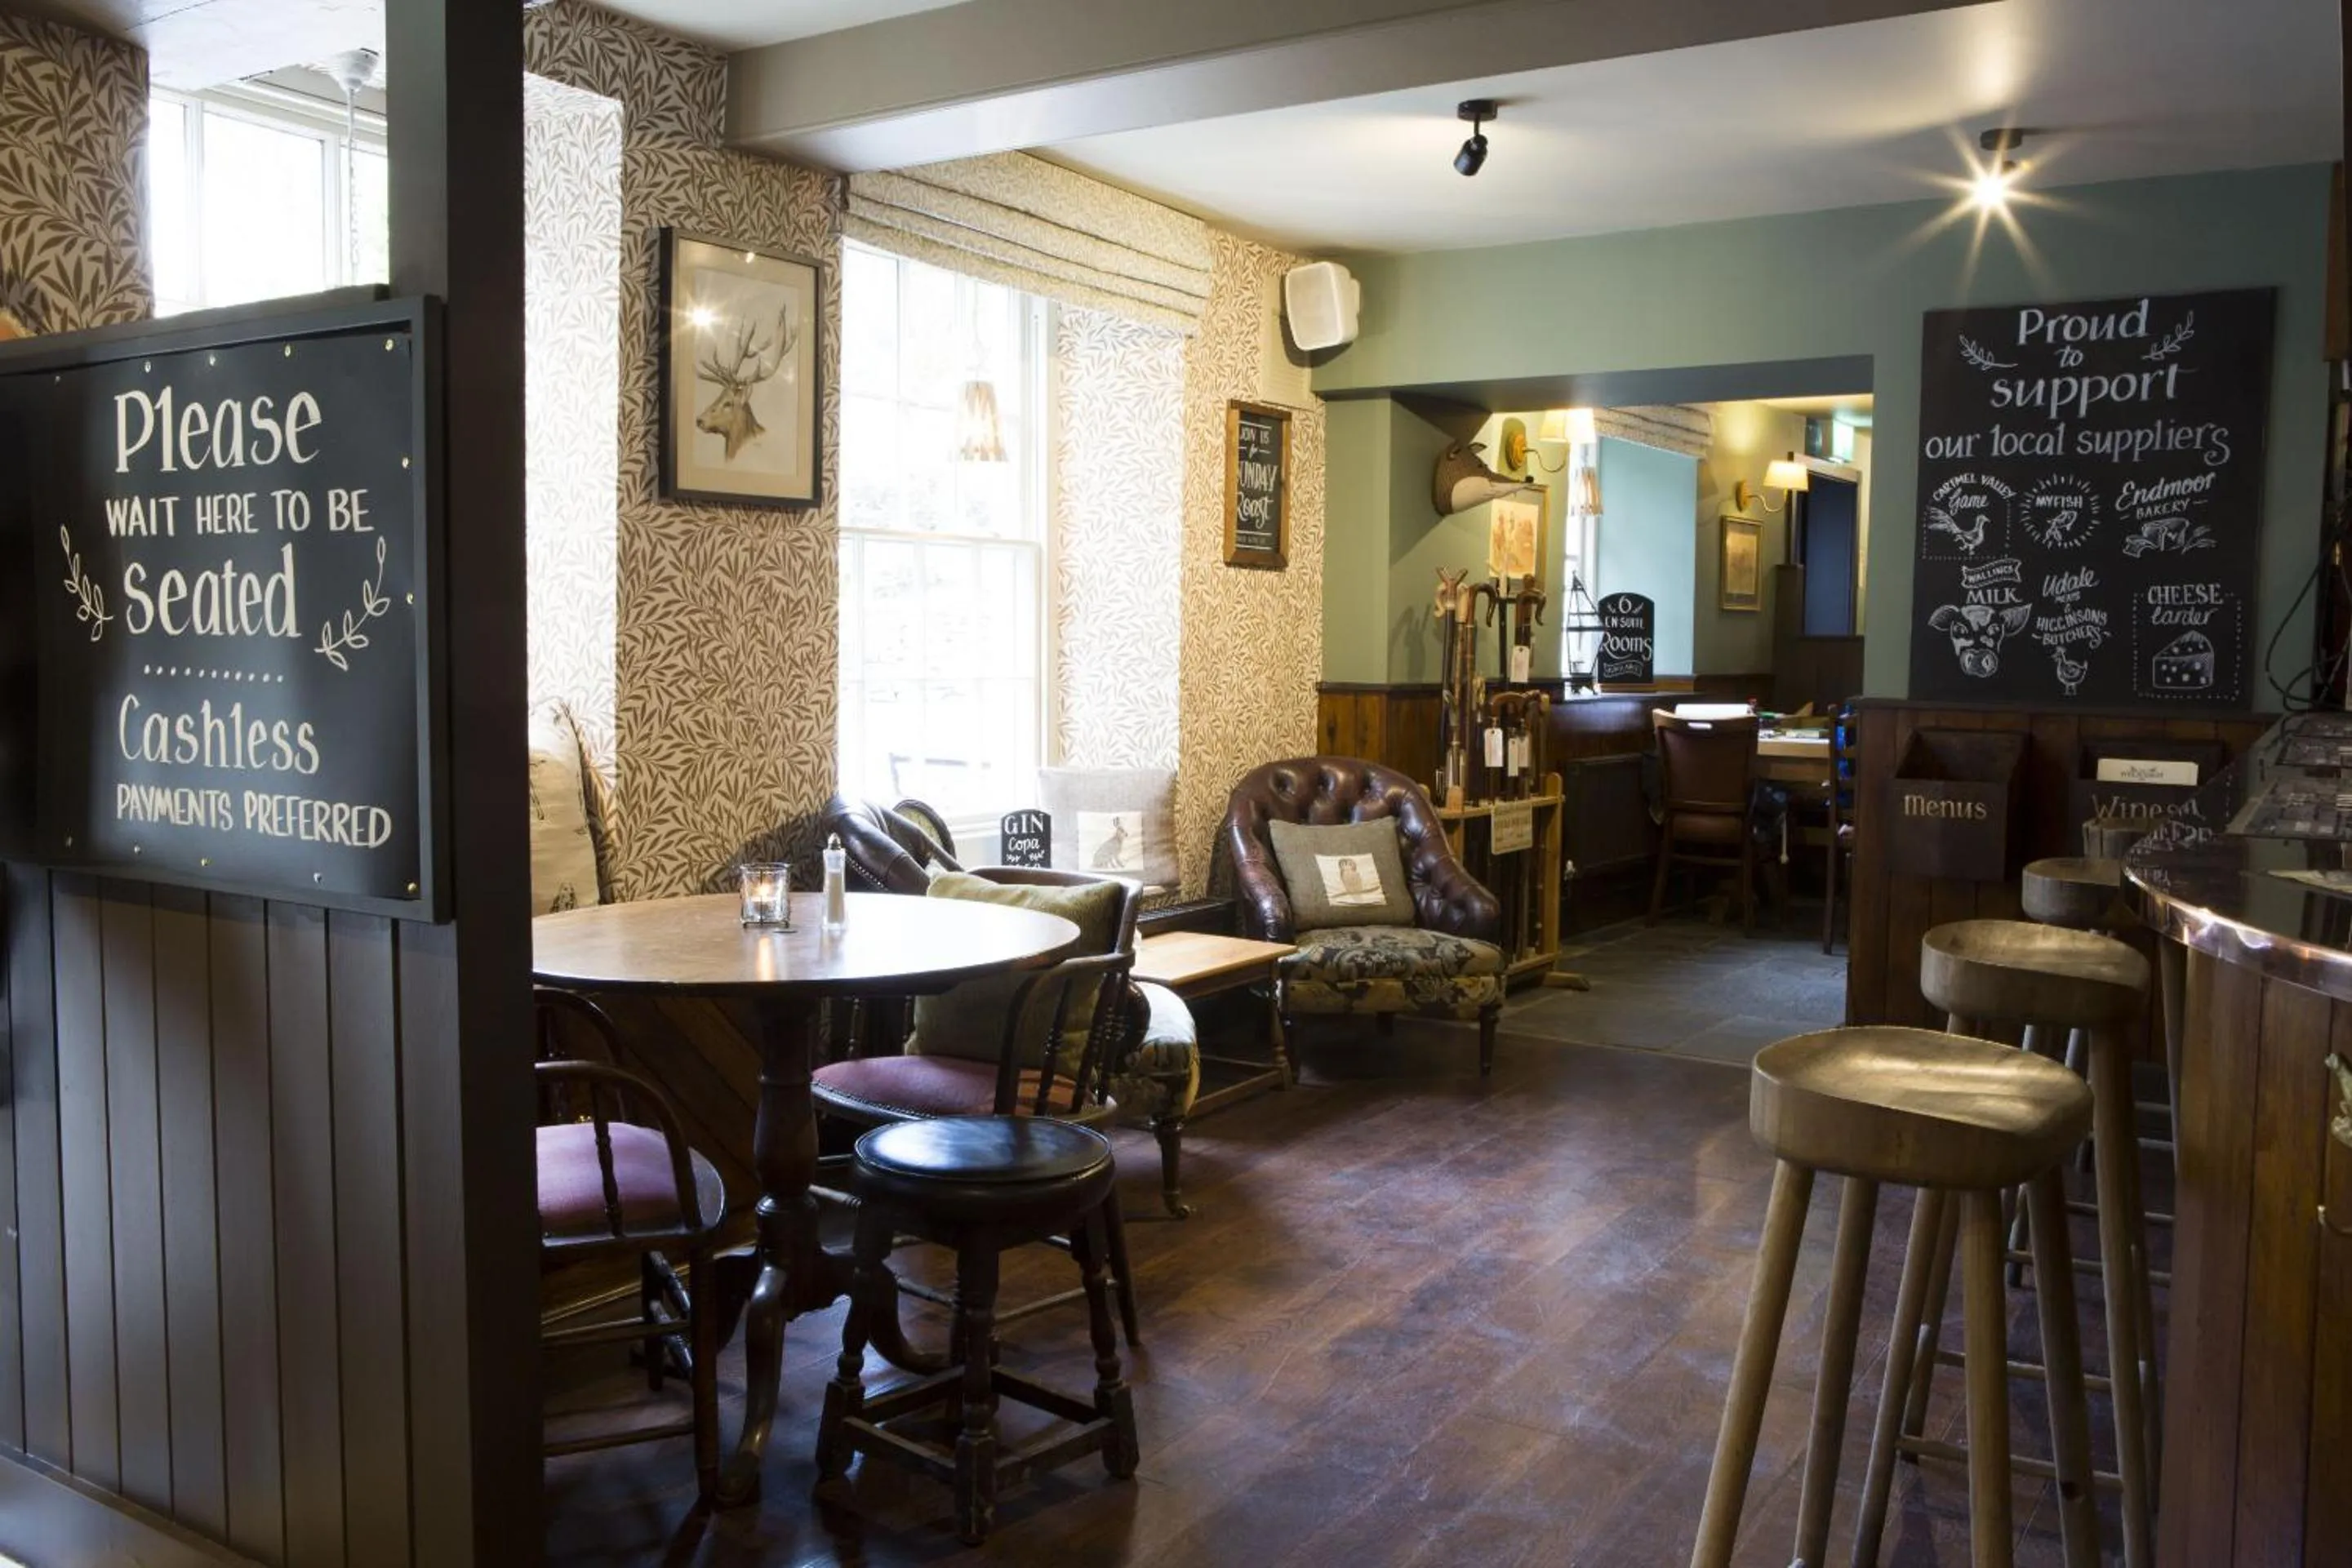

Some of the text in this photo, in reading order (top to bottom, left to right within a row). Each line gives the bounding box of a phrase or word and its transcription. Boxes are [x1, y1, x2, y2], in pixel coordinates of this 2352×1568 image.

[2017, 298, 2154, 346] Proud
[2055, 345, 2084, 367] to
[1990, 363, 2198, 419] support
[114, 385, 322, 473] Please
[1925, 419, 2230, 466] our local suppliers
[1238, 461, 1278, 491] UNDAY
[1932, 473, 2018, 501] CARTMEL VALLEY
[1948, 487, 1989, 516] Game
[2035, 495, 2083, 509] MYFISH
[2114, 471, 2216, 511] Endmoor
[105, 488, 375, 537] WAIT HERE TO BE
[2136, 498, 2190, 520] BAKERY
[124, 542, 302, 638] Seated
[1966, 588, 2023, 604] MILK
[2043, 566, 2100, 597] Udale
[2148, 583, 2223, 605] CHEESE
[1619, 595, 1632, 614] 6
[2152, 606, 2218, 625] larder
[2043, 625, 2101, 649] BUTCHERS
[118, 694, 320, 774] Cashless
[117, 784, 392, 849] PAYMENTS PREFERRED
[1904, 793, 1987, 820] Menus
[1004, 813, 1044, 835] GIN
